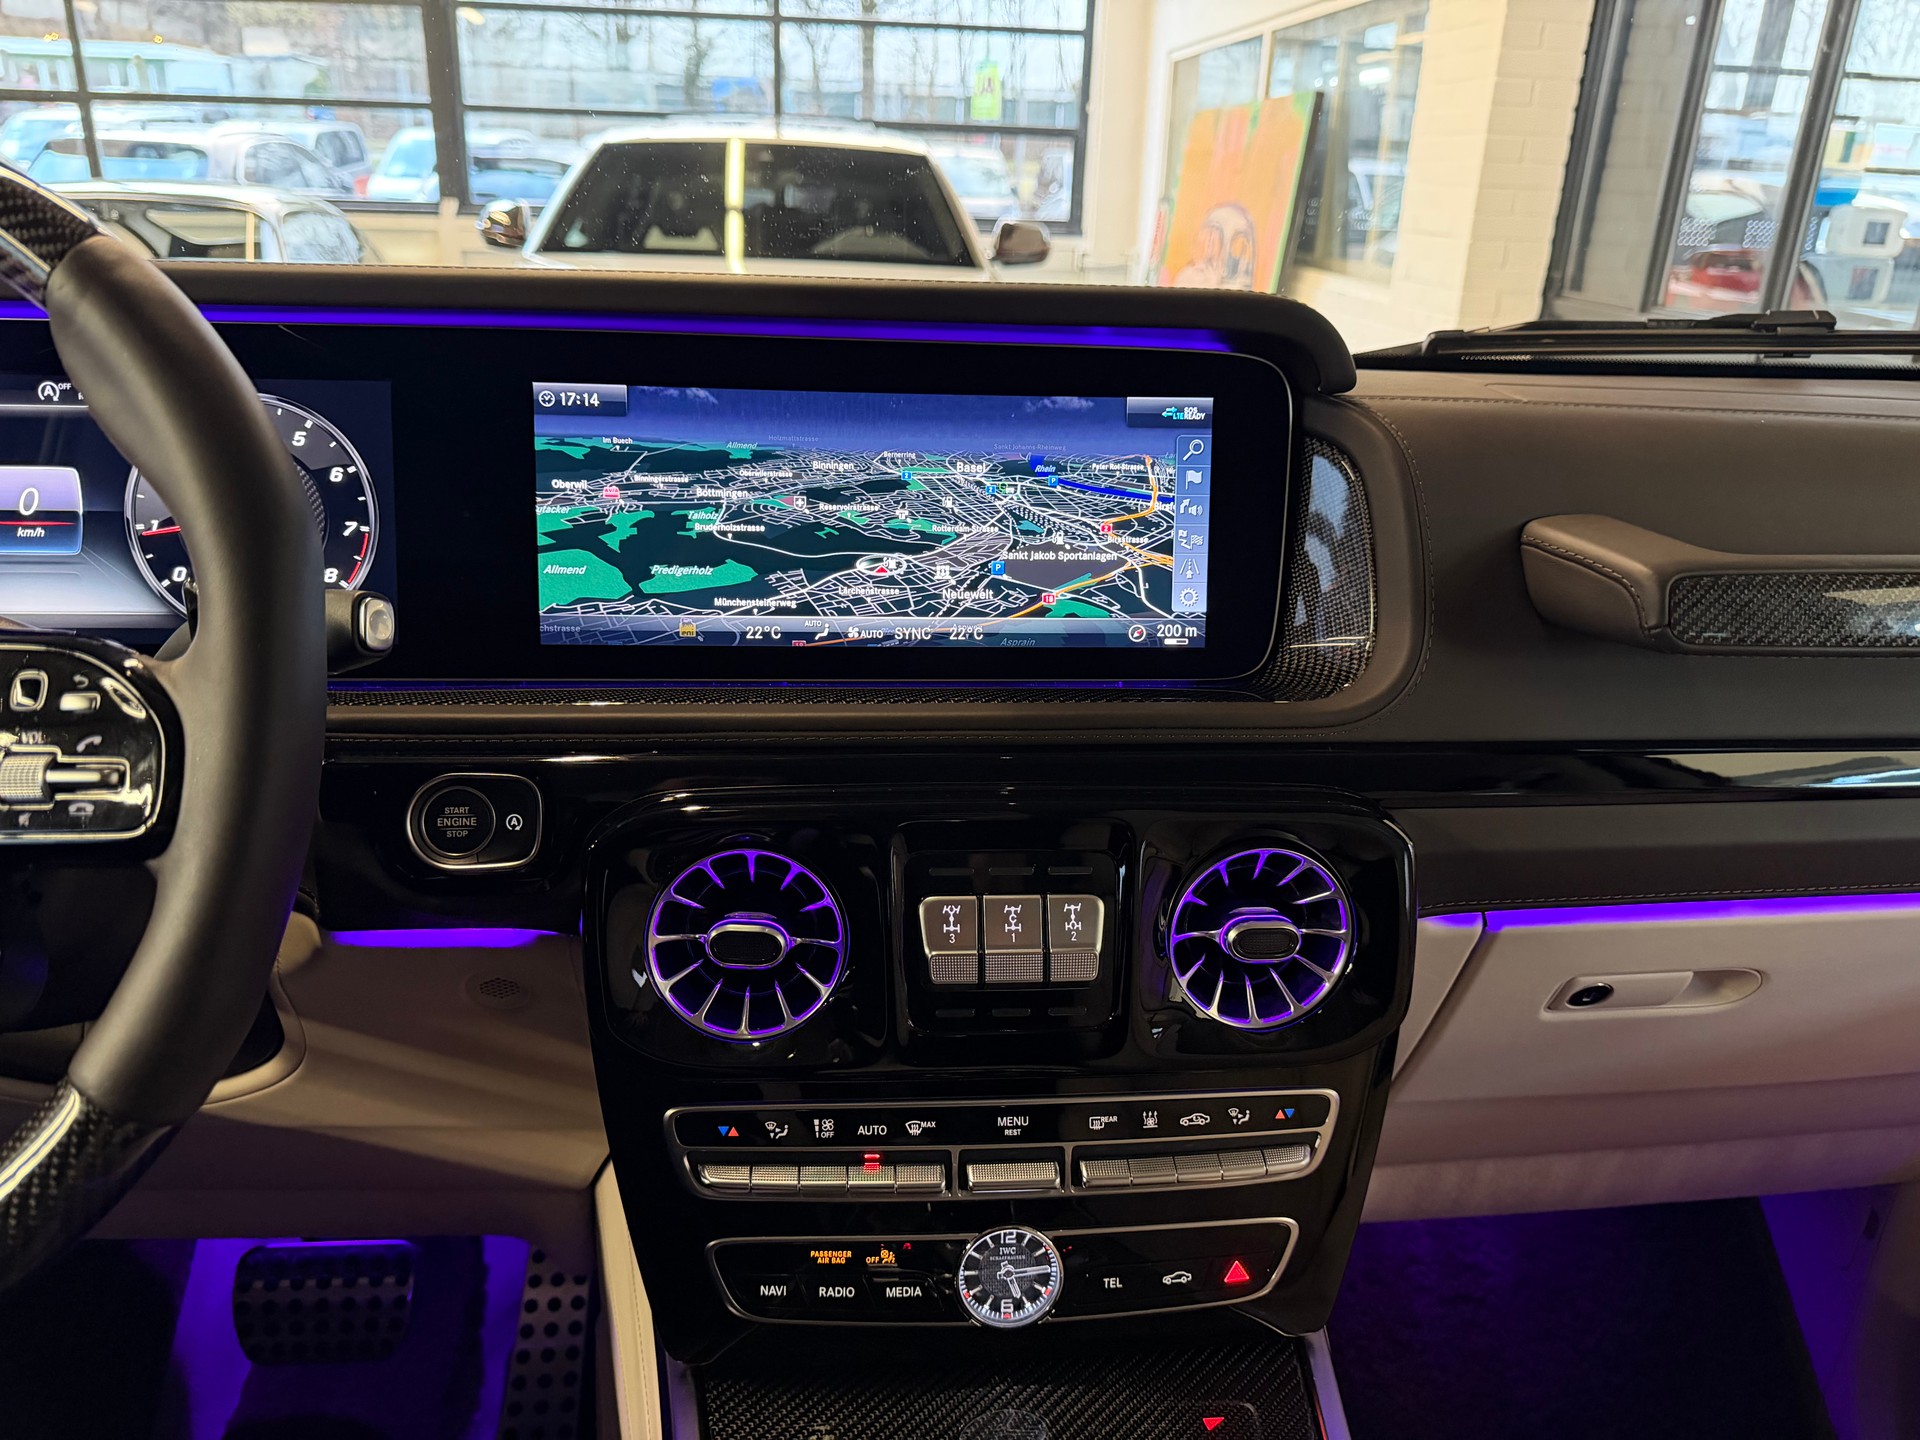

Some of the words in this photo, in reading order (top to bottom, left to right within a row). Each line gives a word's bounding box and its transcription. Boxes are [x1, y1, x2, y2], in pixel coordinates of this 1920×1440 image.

[560, 392, 600, 407] 17:14
[1173, 412, 1184, 420] LTE
[1183, 412, 1206, 420] READY
[291, 431, 306, 447] 5
[726, 441, 758, 449] Allmend
[883, 451, 916, 460] Bernerring
[812, 461, 854, 471] Binningen
[956, 462, 986, 473] Basel
[1034, 465, 1056, 473] Rhein
[329, 467, 344, 482] 6
[739, 469, 793, 478] Oberwilerstrasse
[551, 479, 588, 490] Oberwil
[634, 475, 689, 484] Binningerstrasse
[18, 487, 40, 516] 0
[819, 503, 880, 511] Reservoirstrasse
[687, 510, 720, 520] Talholz
[16, 525, 46, 540] km/h
[343, 521, 358, 537] 7
[694, 523, 765, 532] Bruderholzstrasse
[931, 524, 999, 533] Rotterdam-Strasse
[1107, 536, 1149, 544] Birsstrasse
[1002, 551, 1029, 560] Sankt
[1029, 551, 1056, 561] Jakob
[1058, 551, 1118, 563] Sportanlagen
[172, 567, 187, 582] 0
[543, 564, 587, 575] Allmend
[651, 564, 714, 577] Predigerholz
[324, 568, 339, 583] 8
[942, 589, 994, 601] Neuewelt
[714, 598, 797, 609] Münchensteinerweg
[746, 626, 781, 639] 22°C
[860, 630, 884, 639] AUTO
[894, 627, 932, 640] SYNC
[950, 627, 984, 640] 22°C
[1157, 624, 1181, 637] 200
[1185, 627, 1198, 637] m
[1000, 638, 1036, 647] Asprain
[437, 817, 477, 827] ENGINE
[446, 830, 469, 838] STOP
[949, 933, 956, 944] 3
[1010, 933, 1016, 943] 1
[1071, 931, 1077, 941] 2
[997, 1116, 1029, 1127] MENU
[820, 1130, 835, 1138] OFF
[857, 1125, 888, 1136] AUTO
[1000, 1231, 1016, 1244] 12
[810, 1250, 852, 1258] PASSENGER
[999, 1247, 1016, 1255] IWC
[817, 1257, 830, 1265] AIR
[831, 1257, 846, 1265] BAG
[866, 1256, 880, 1264] OFF
[1103, 1277, 1123, 1289] TEL
[760, 1285, 787, 1297] NAVI
[818, 1286, 855, 1298] RADIO
[886, 1286, 922, 1298] MEDIA
